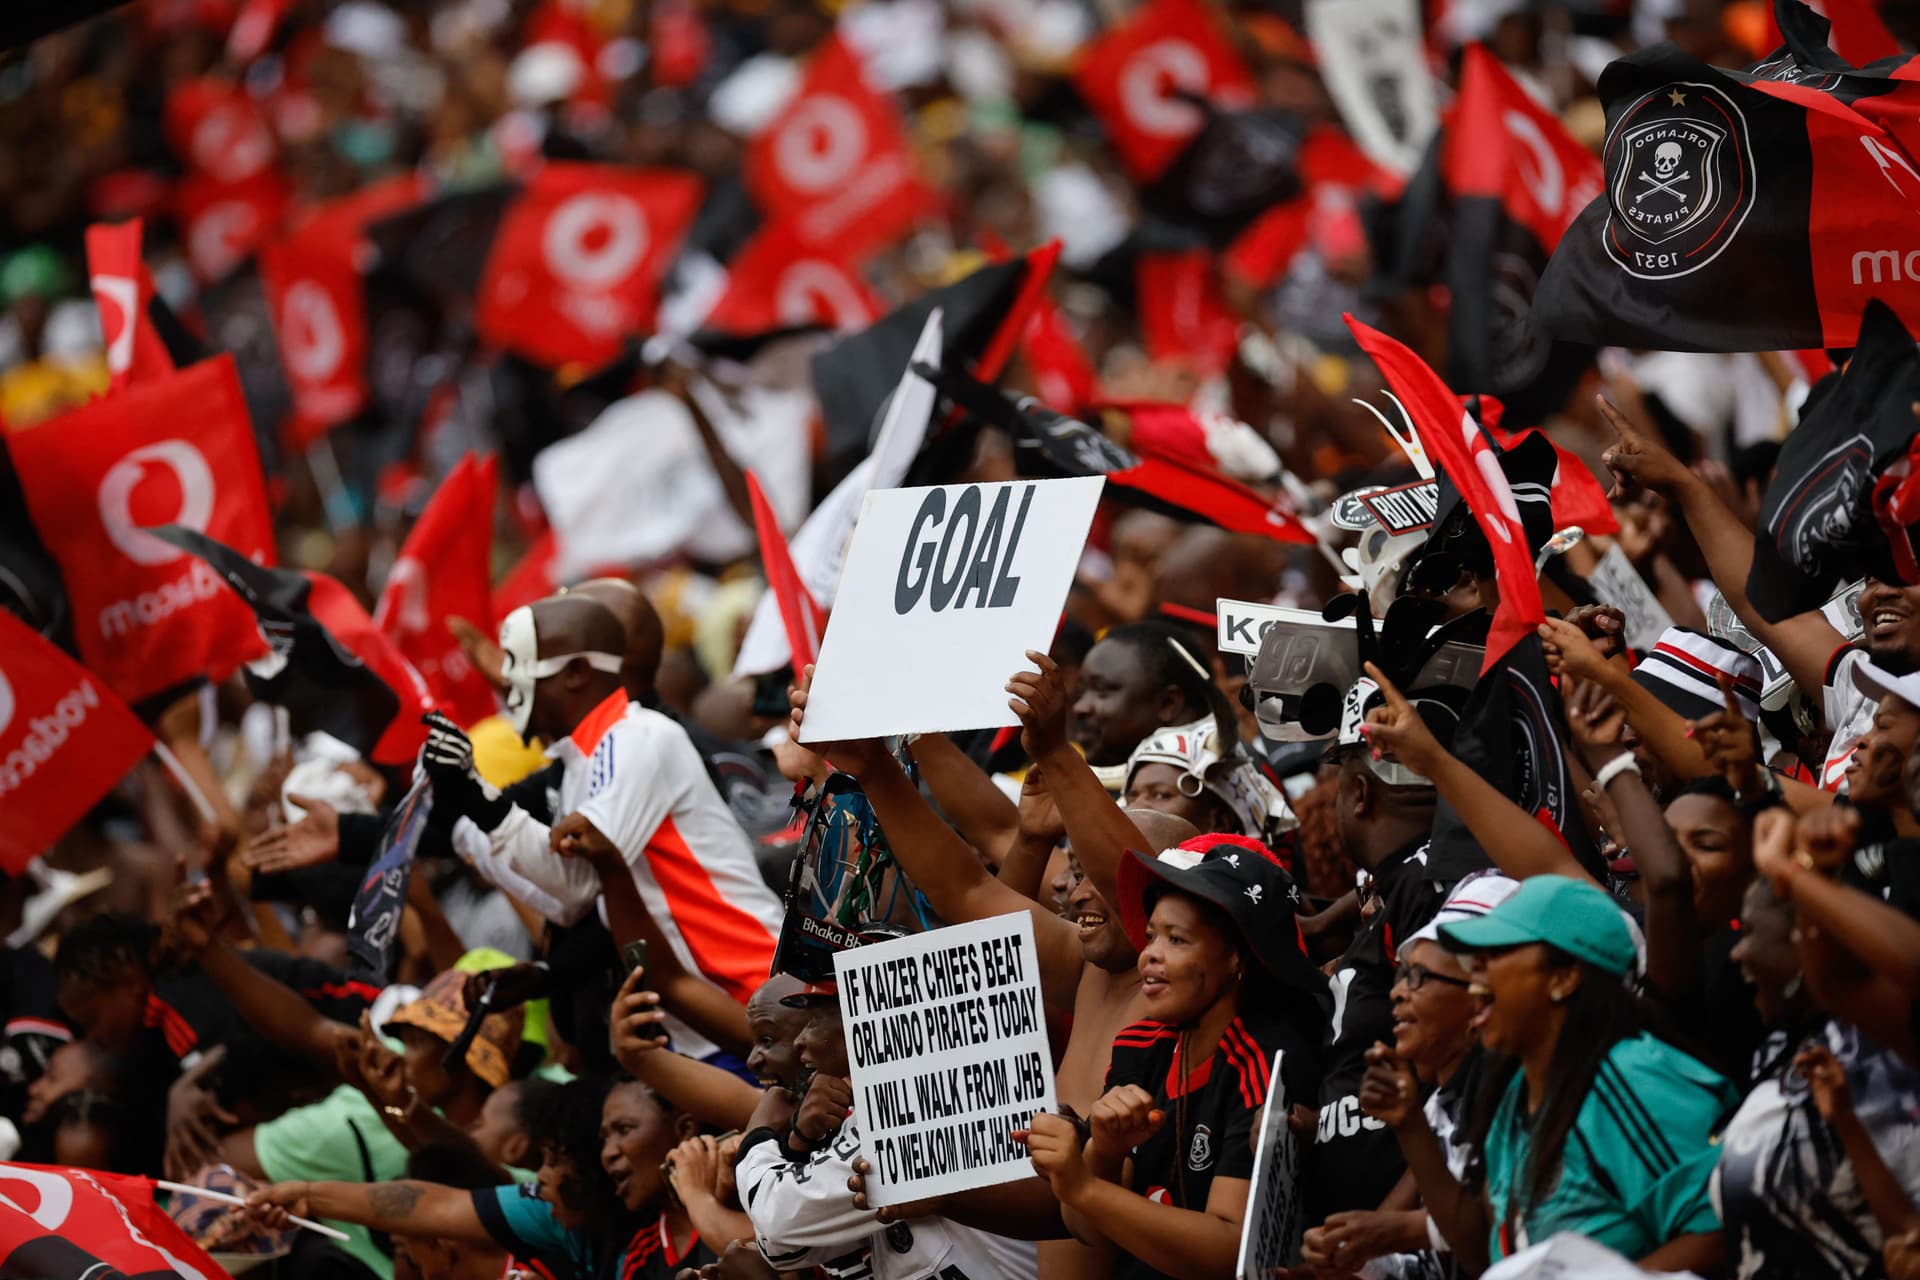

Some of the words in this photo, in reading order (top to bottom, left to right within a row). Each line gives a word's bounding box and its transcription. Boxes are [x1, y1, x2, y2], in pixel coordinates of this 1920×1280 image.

[1406, 483, 1440, 521] NE
[894, 485, 1036, 615] GOAL
[802, 917, 843, 945] Bhaka
[843, 969, 859, 1018] IF
[862, 956, 924, 1014] KAIZER
[922, 943, 981, 1001] CHIEFS
[981, 934, 1024, 989] BEAT
[852, 1011, 924, 1068] ORLANDO
[924, 997, 989, 1053] PIRATES
[989, 986, 1038, 1040] TODAY
[865, 1086, 874, 1132] I
[874, 1078, 916, 1130] WILL
[914, 1068, 964, 1122] WALK
[963, 1058, 1010, 1112] FROM
[1013, 1051, 1045, 1103] JHB
[874, 1137, 898, 1186] TO
[899, 1125, 959, 1182] WELKOM
[959, 1107, 1047, 1170] MATJHABE
